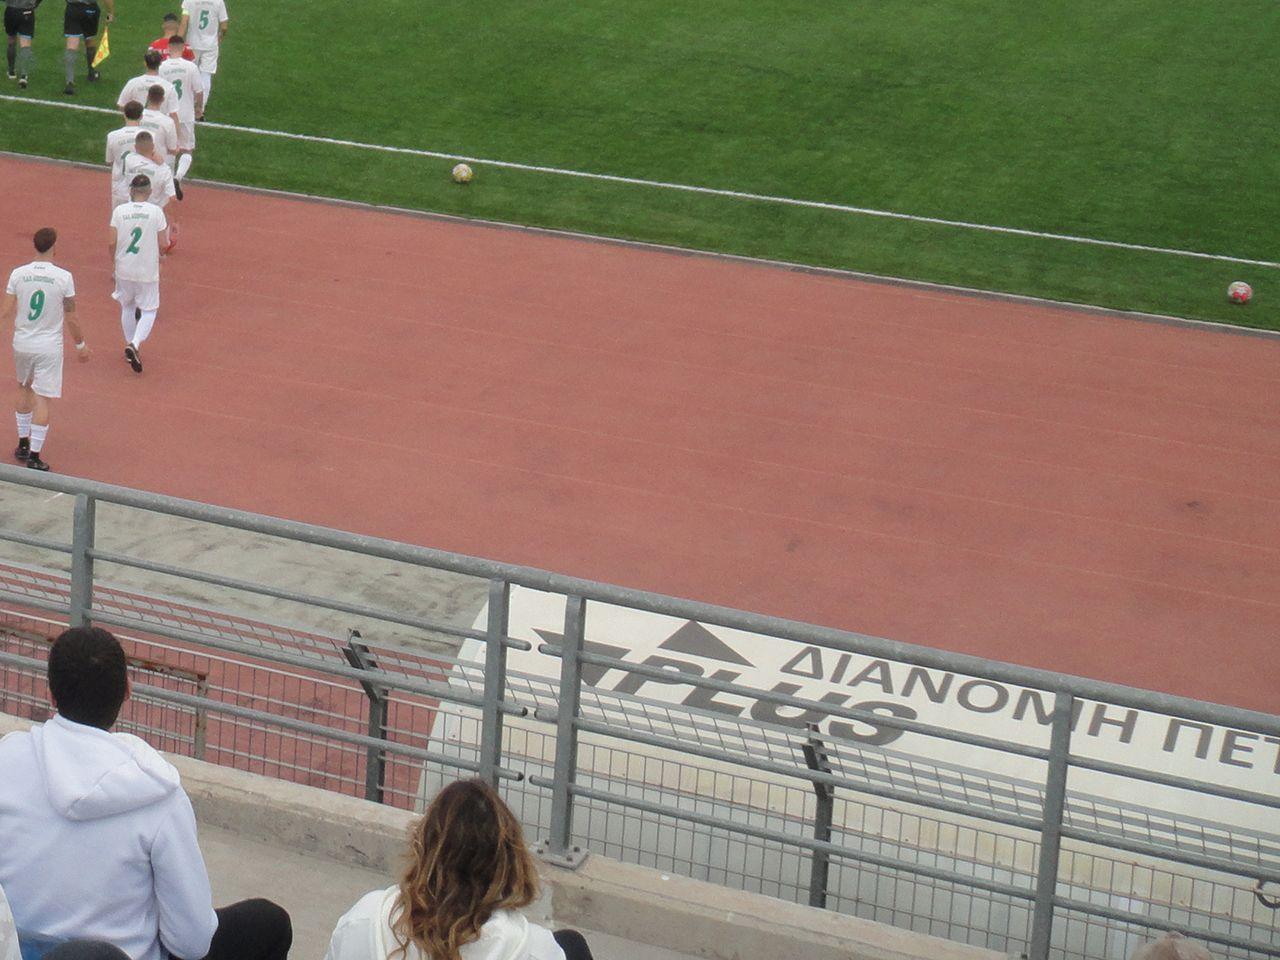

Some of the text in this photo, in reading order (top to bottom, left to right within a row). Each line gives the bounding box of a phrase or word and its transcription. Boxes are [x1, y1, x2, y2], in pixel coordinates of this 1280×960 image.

[198, 9, 210, 30] 5
[126, 226, 143, 255] 2
[27, 289, 46, 321] 9
[613, 654, 918, 747] PLUS
[779, 645, 1139, 745] ΔΙΑΝΟΜΗ
